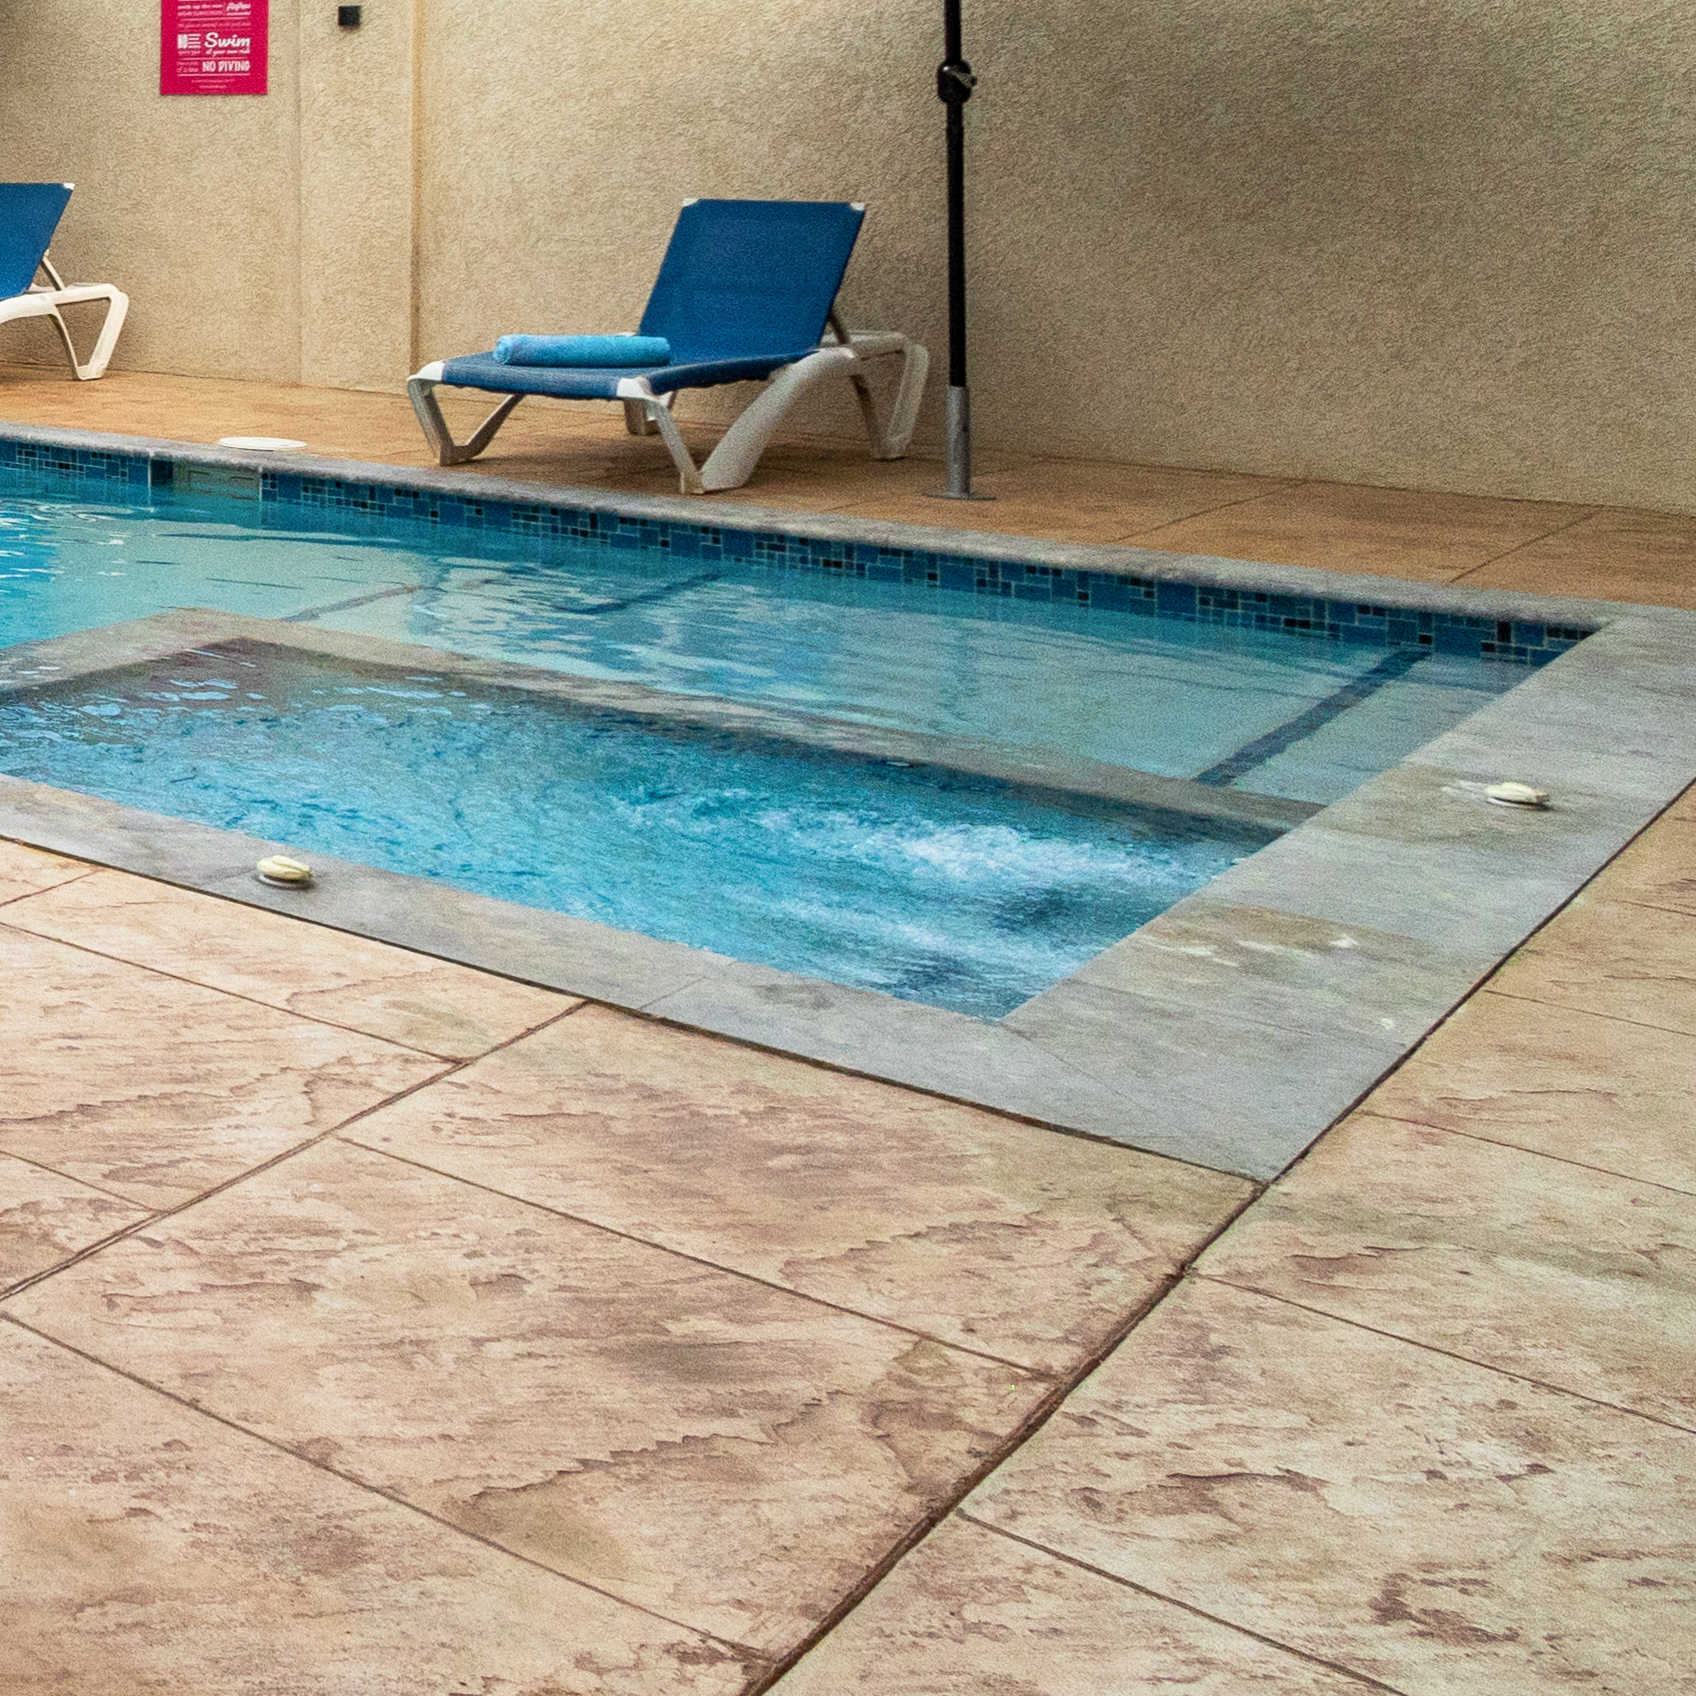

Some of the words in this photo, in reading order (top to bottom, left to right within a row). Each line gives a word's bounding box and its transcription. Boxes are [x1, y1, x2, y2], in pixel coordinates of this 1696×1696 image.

[204, 32, 251, 48] Swim
[202, 60, 216, 72] NO
[218, 59, 251, 72] DIVING
